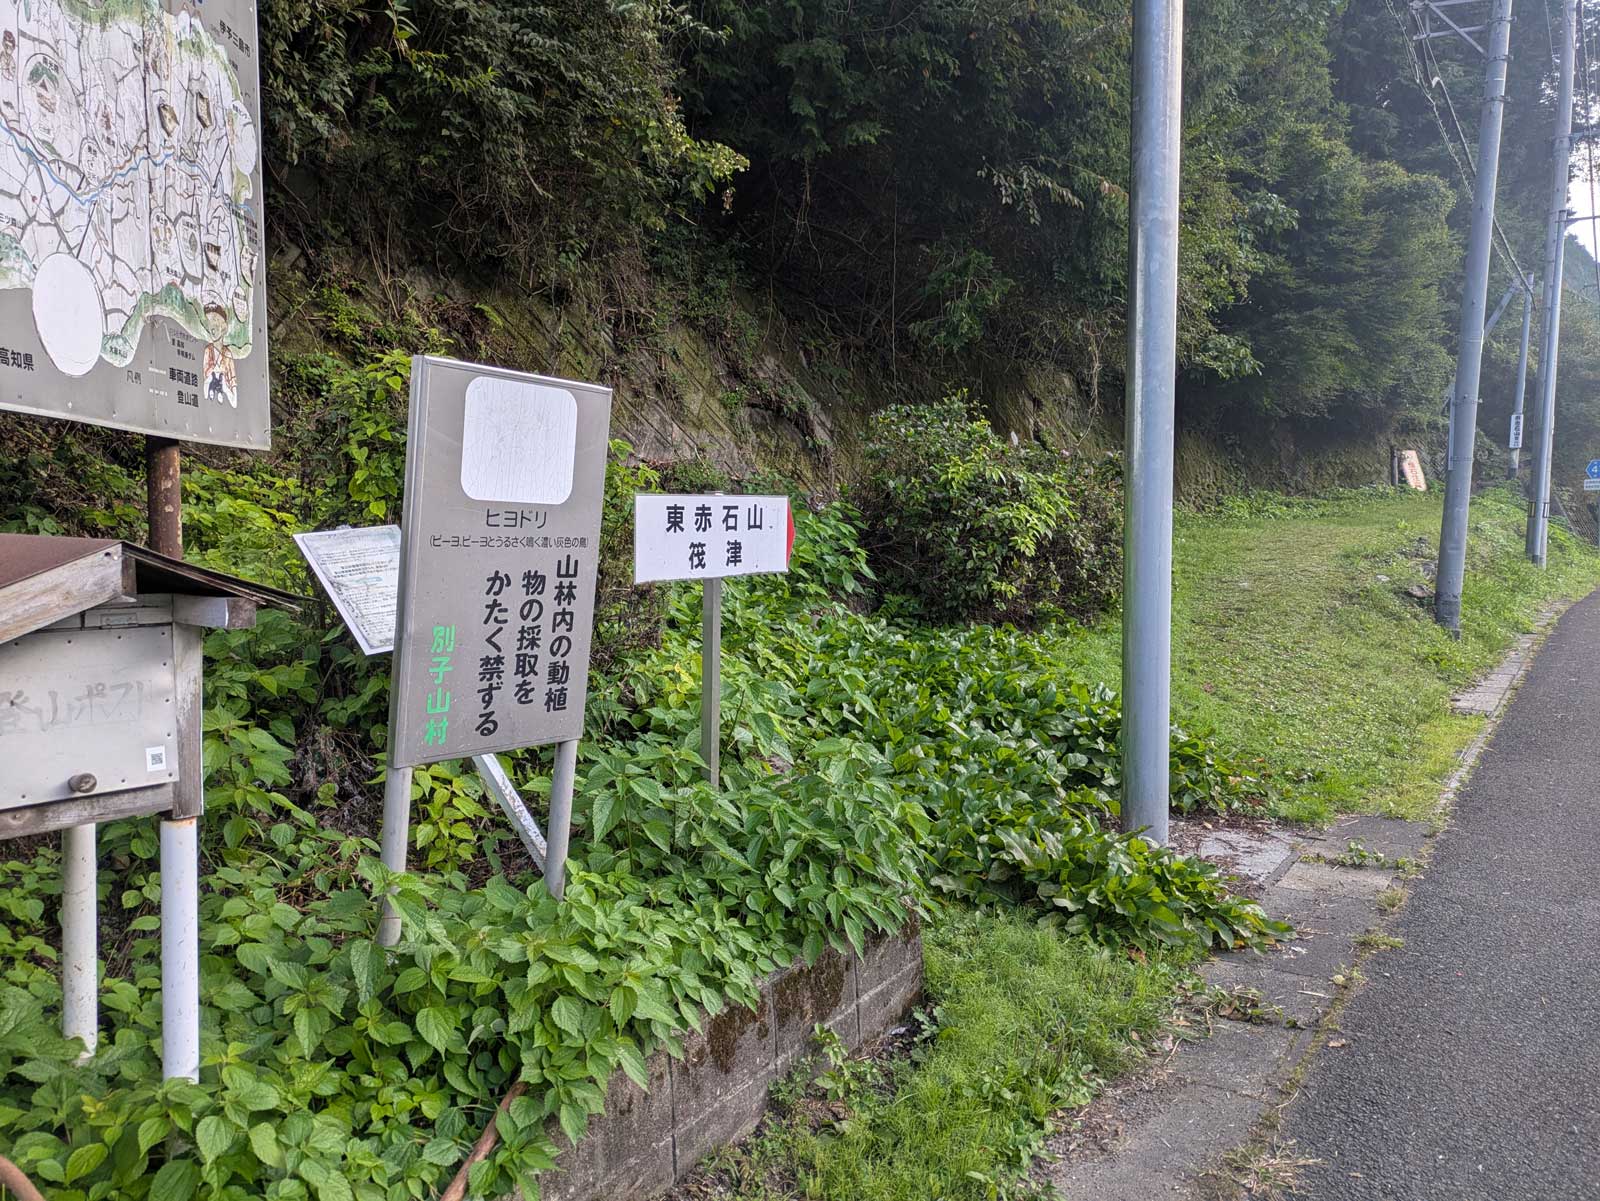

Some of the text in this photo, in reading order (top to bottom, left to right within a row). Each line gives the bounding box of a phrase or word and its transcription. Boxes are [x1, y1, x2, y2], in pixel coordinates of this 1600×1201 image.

[0, 346, 34, 371] 高知県
[177, 390, 199, 408] 登山道
[486, 508, 547, 529] ヒヨドリ
[665, 503, 763, 533] 東赤石山
[688, 540, 743, 570] 筏津
[513, 570, 546, 705] 物の採取を
[543, 554, 579, 713] 山林内の動植
[475, 570, 512, 737] かたく禁ずる
[425, 624, 455, 746] 別子山村
